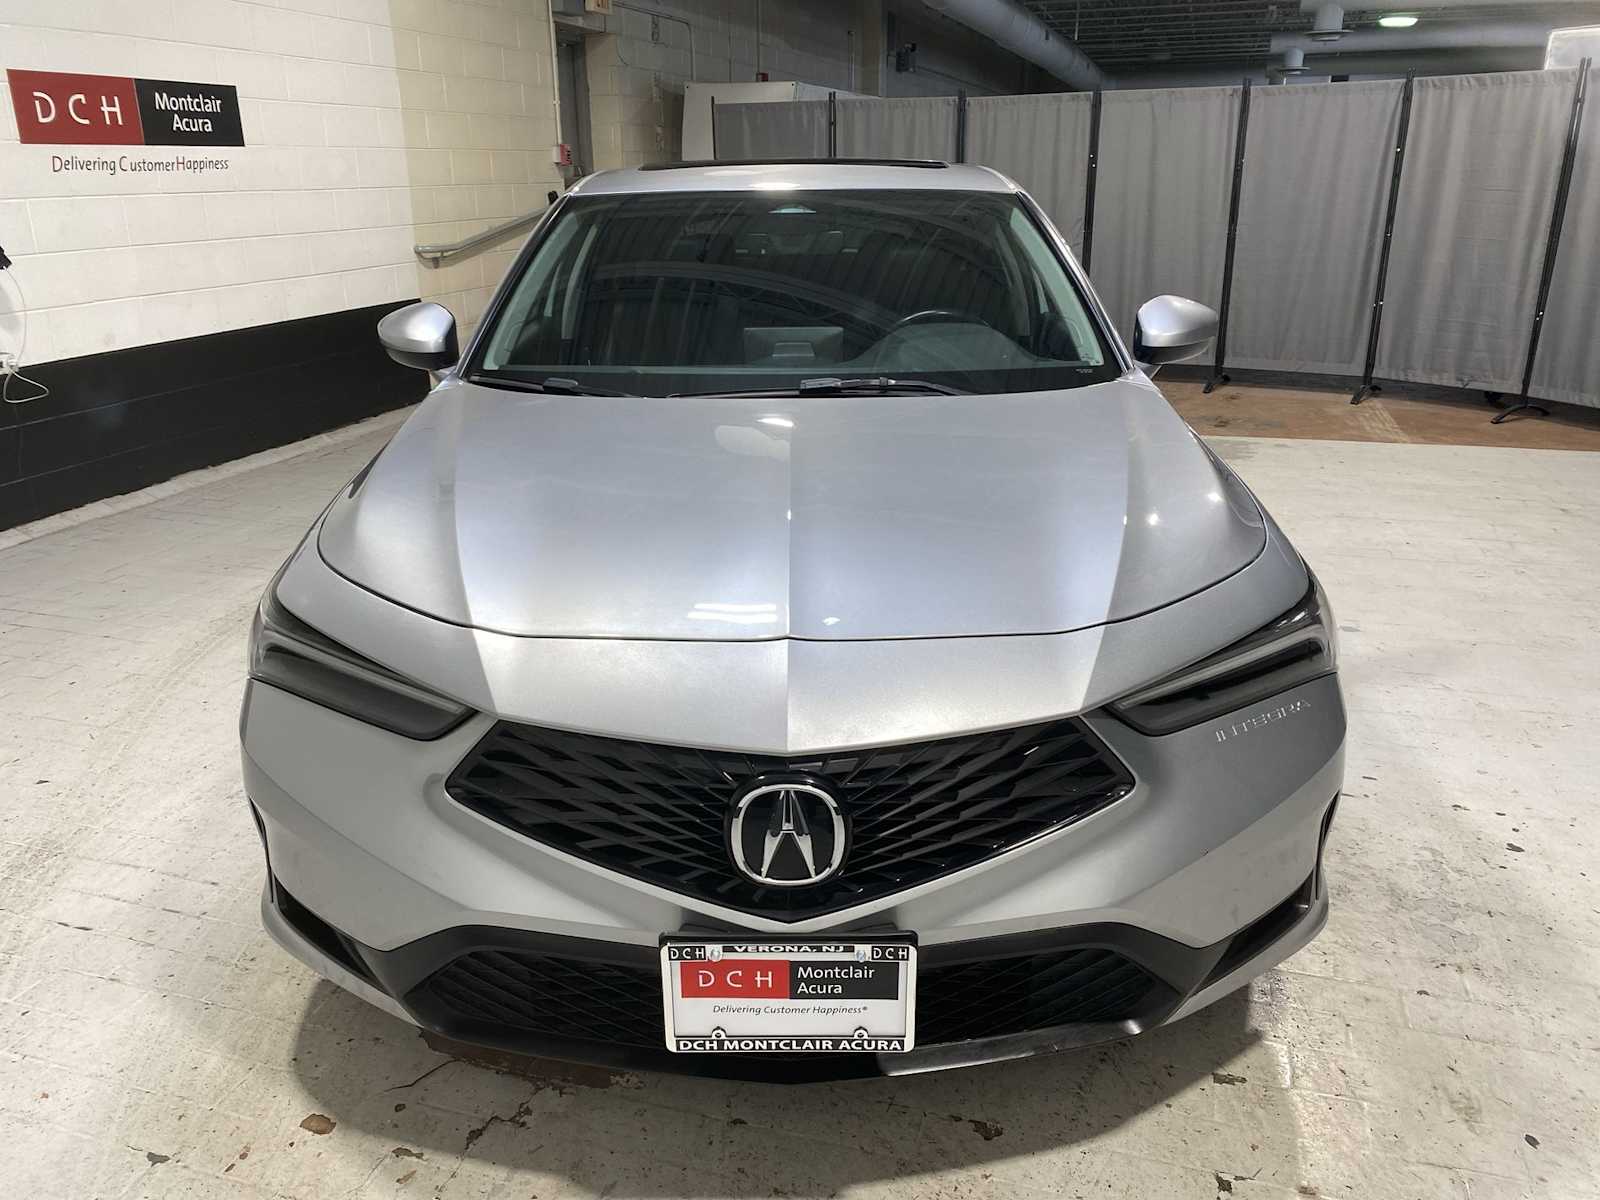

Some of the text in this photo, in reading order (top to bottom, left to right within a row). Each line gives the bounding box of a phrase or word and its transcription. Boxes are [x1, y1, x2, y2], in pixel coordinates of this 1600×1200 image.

[32, 91, 124, 126] DCH
[154, 91, 222, 114] Montclair
[172, 114, 213, 132] Acura
[52, 155, 116, 175] Delivering
[669, 947, 705, 960] DCH
[734, 945, 844, 953] VERONA, NJ
[872, 947, 908, 960] DCH
[698, 970, 773, 988] DCH
[797, 966, 875, 979] Montclair
[796, 981, 843, 995] Acura
[712, 1005, 761, 1016] Delivering
[763, 1005, 810, 1015] Customer
[679, 1040, 902, 1050] DCH MONTCLAIR ACURA
